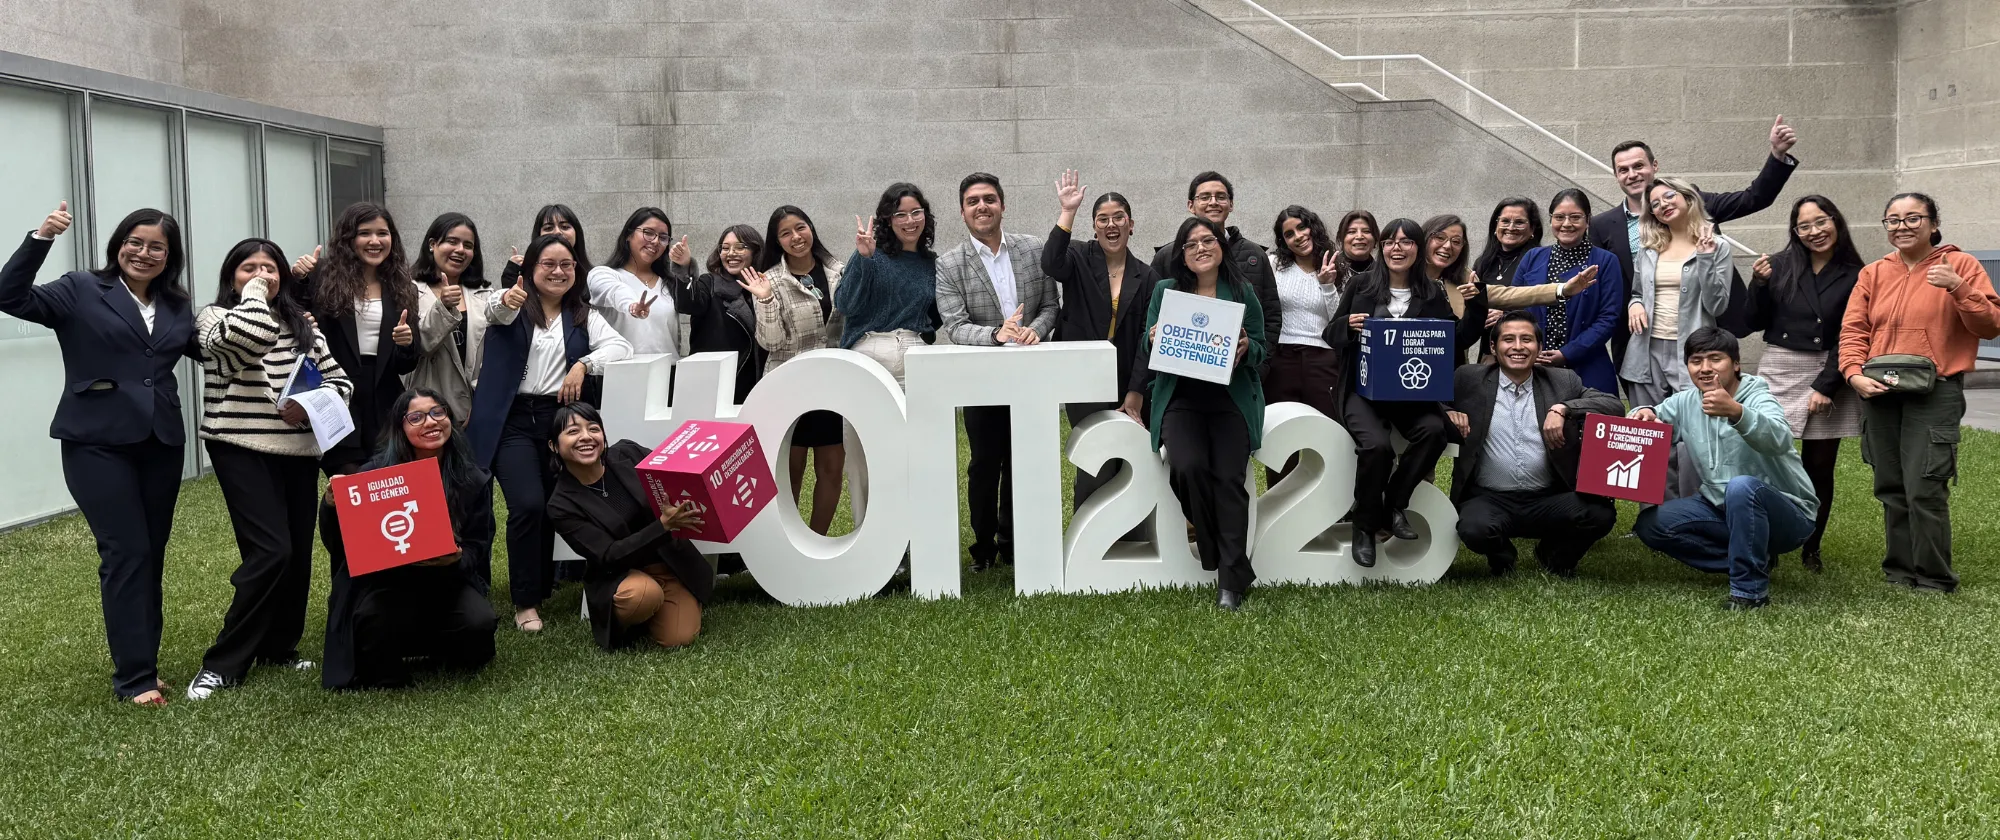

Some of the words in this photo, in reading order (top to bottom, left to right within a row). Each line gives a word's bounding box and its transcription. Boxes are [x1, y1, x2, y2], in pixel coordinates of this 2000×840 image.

[1162, 324, 1231, 347] OBJETIVOS
[1383, 329, 1397, 345] 17
[1402, 330, 1430, 338] ALIANZAS
[1430, 330, 1446, 338] PARA
[1161, 336, 1172, 345] DE
[1174, 338, 1228, 356] DESARROLLO
[1159, 345, 1227, 367] SOSTENIBLE
[1595, 422, 1605, 439] 8
[1610, 424, 1637, 435] TRABAJO
[1638, 429, 1664, 439] DECENTE
[1607, 441, 1642, 452] ECONÓMICO
[1614, 433, 1652, 446] CRECIMIENTO
[648, 455, 668, 466] 10
[368, 475, 404, 491] IGUALDAD
[709, 469, 723, 490] 10
[348, 485, 361, 506] 5
[370, 491, 380, 502] DE
[381, 485, 409, 500] GÉNERO
